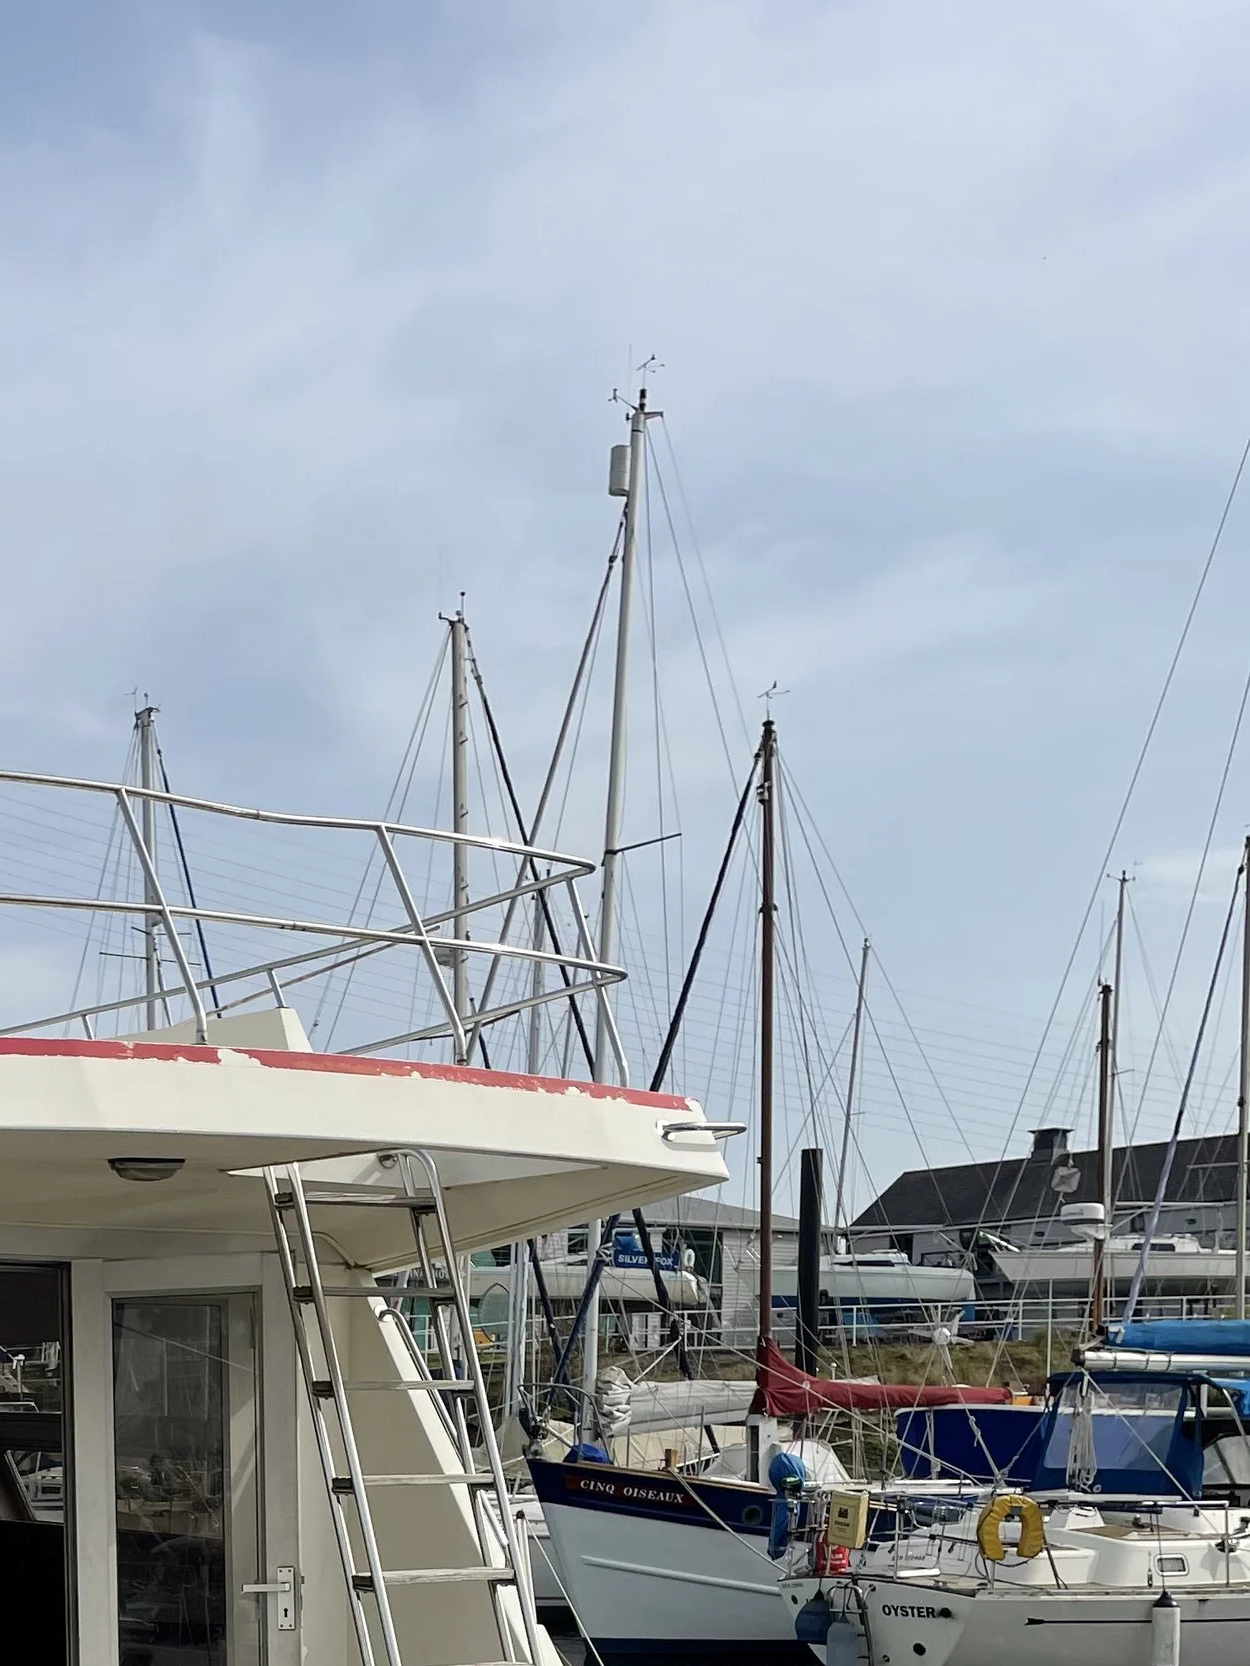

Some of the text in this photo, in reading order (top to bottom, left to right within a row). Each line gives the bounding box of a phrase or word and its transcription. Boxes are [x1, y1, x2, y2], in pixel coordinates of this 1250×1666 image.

[580, 1480, 684, 1503] CINQ OISEAUX
[882, 1604, 937, 1619] OYSTER
